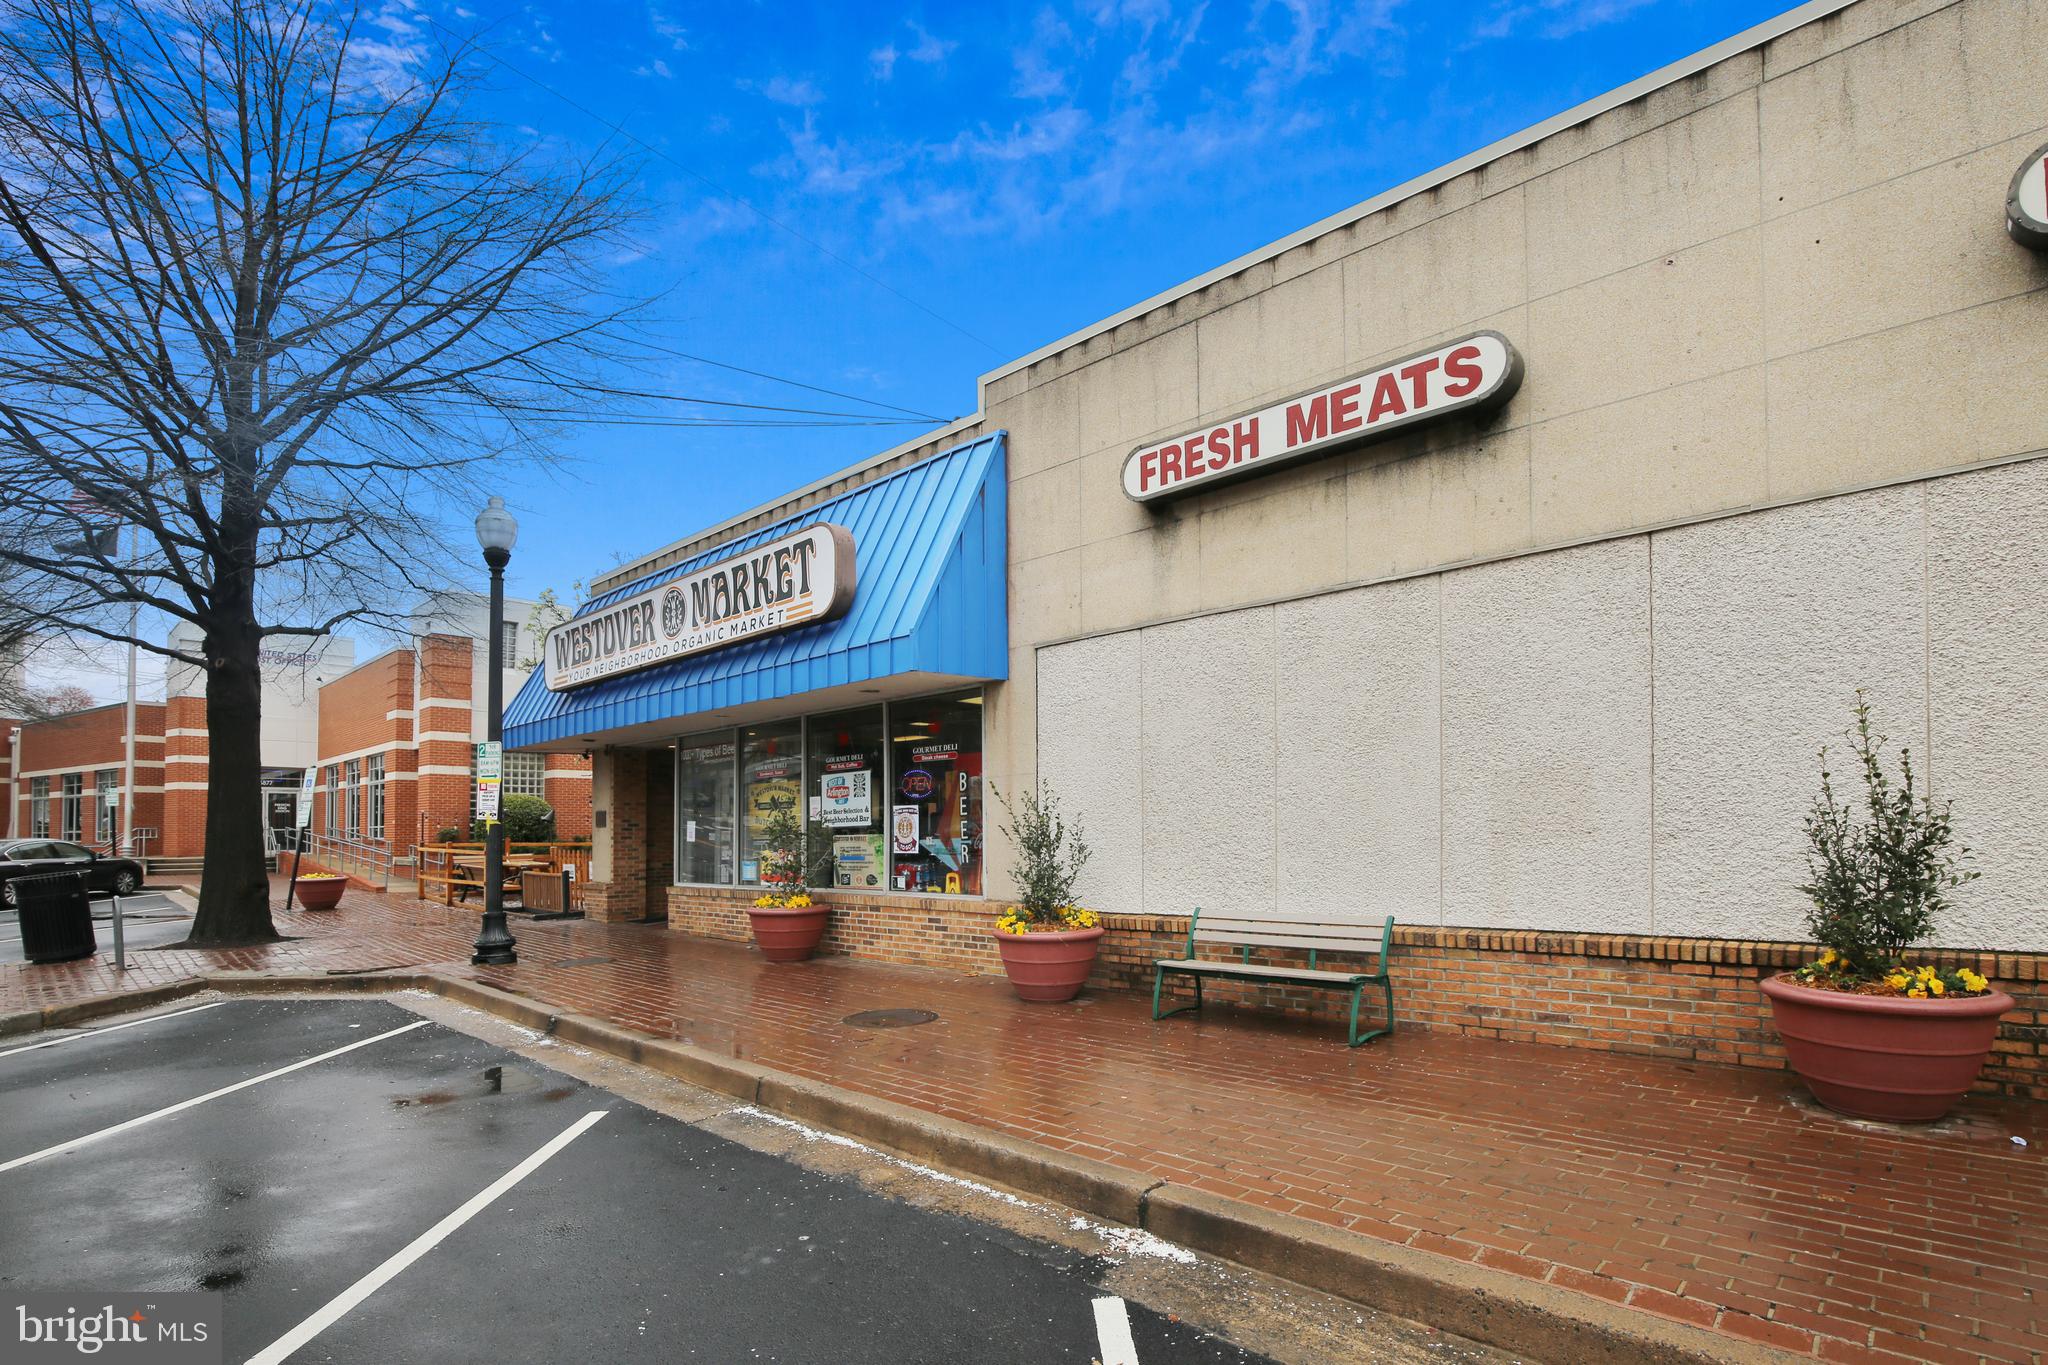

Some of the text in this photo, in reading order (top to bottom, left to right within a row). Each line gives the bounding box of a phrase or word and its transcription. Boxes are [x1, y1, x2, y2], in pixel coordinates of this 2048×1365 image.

[1140, 345, 1483, 492] FRESH MEATS
[553, 537, 816, 672] WESTOVER MARKET
[259, 648, 284, 657] NITED
[567, 609, 785, 681] YOUR NEIGHBORHOOD ORGANIC MARKET
[912, 743, 958, 754] GOURMET DELI
[827, 787, 850, 797] Arlington
[902, 776, 932, 792] OPEN
[823, 815, 859, 824] Neighborhood
[959, 772, 969, 864] BEER
